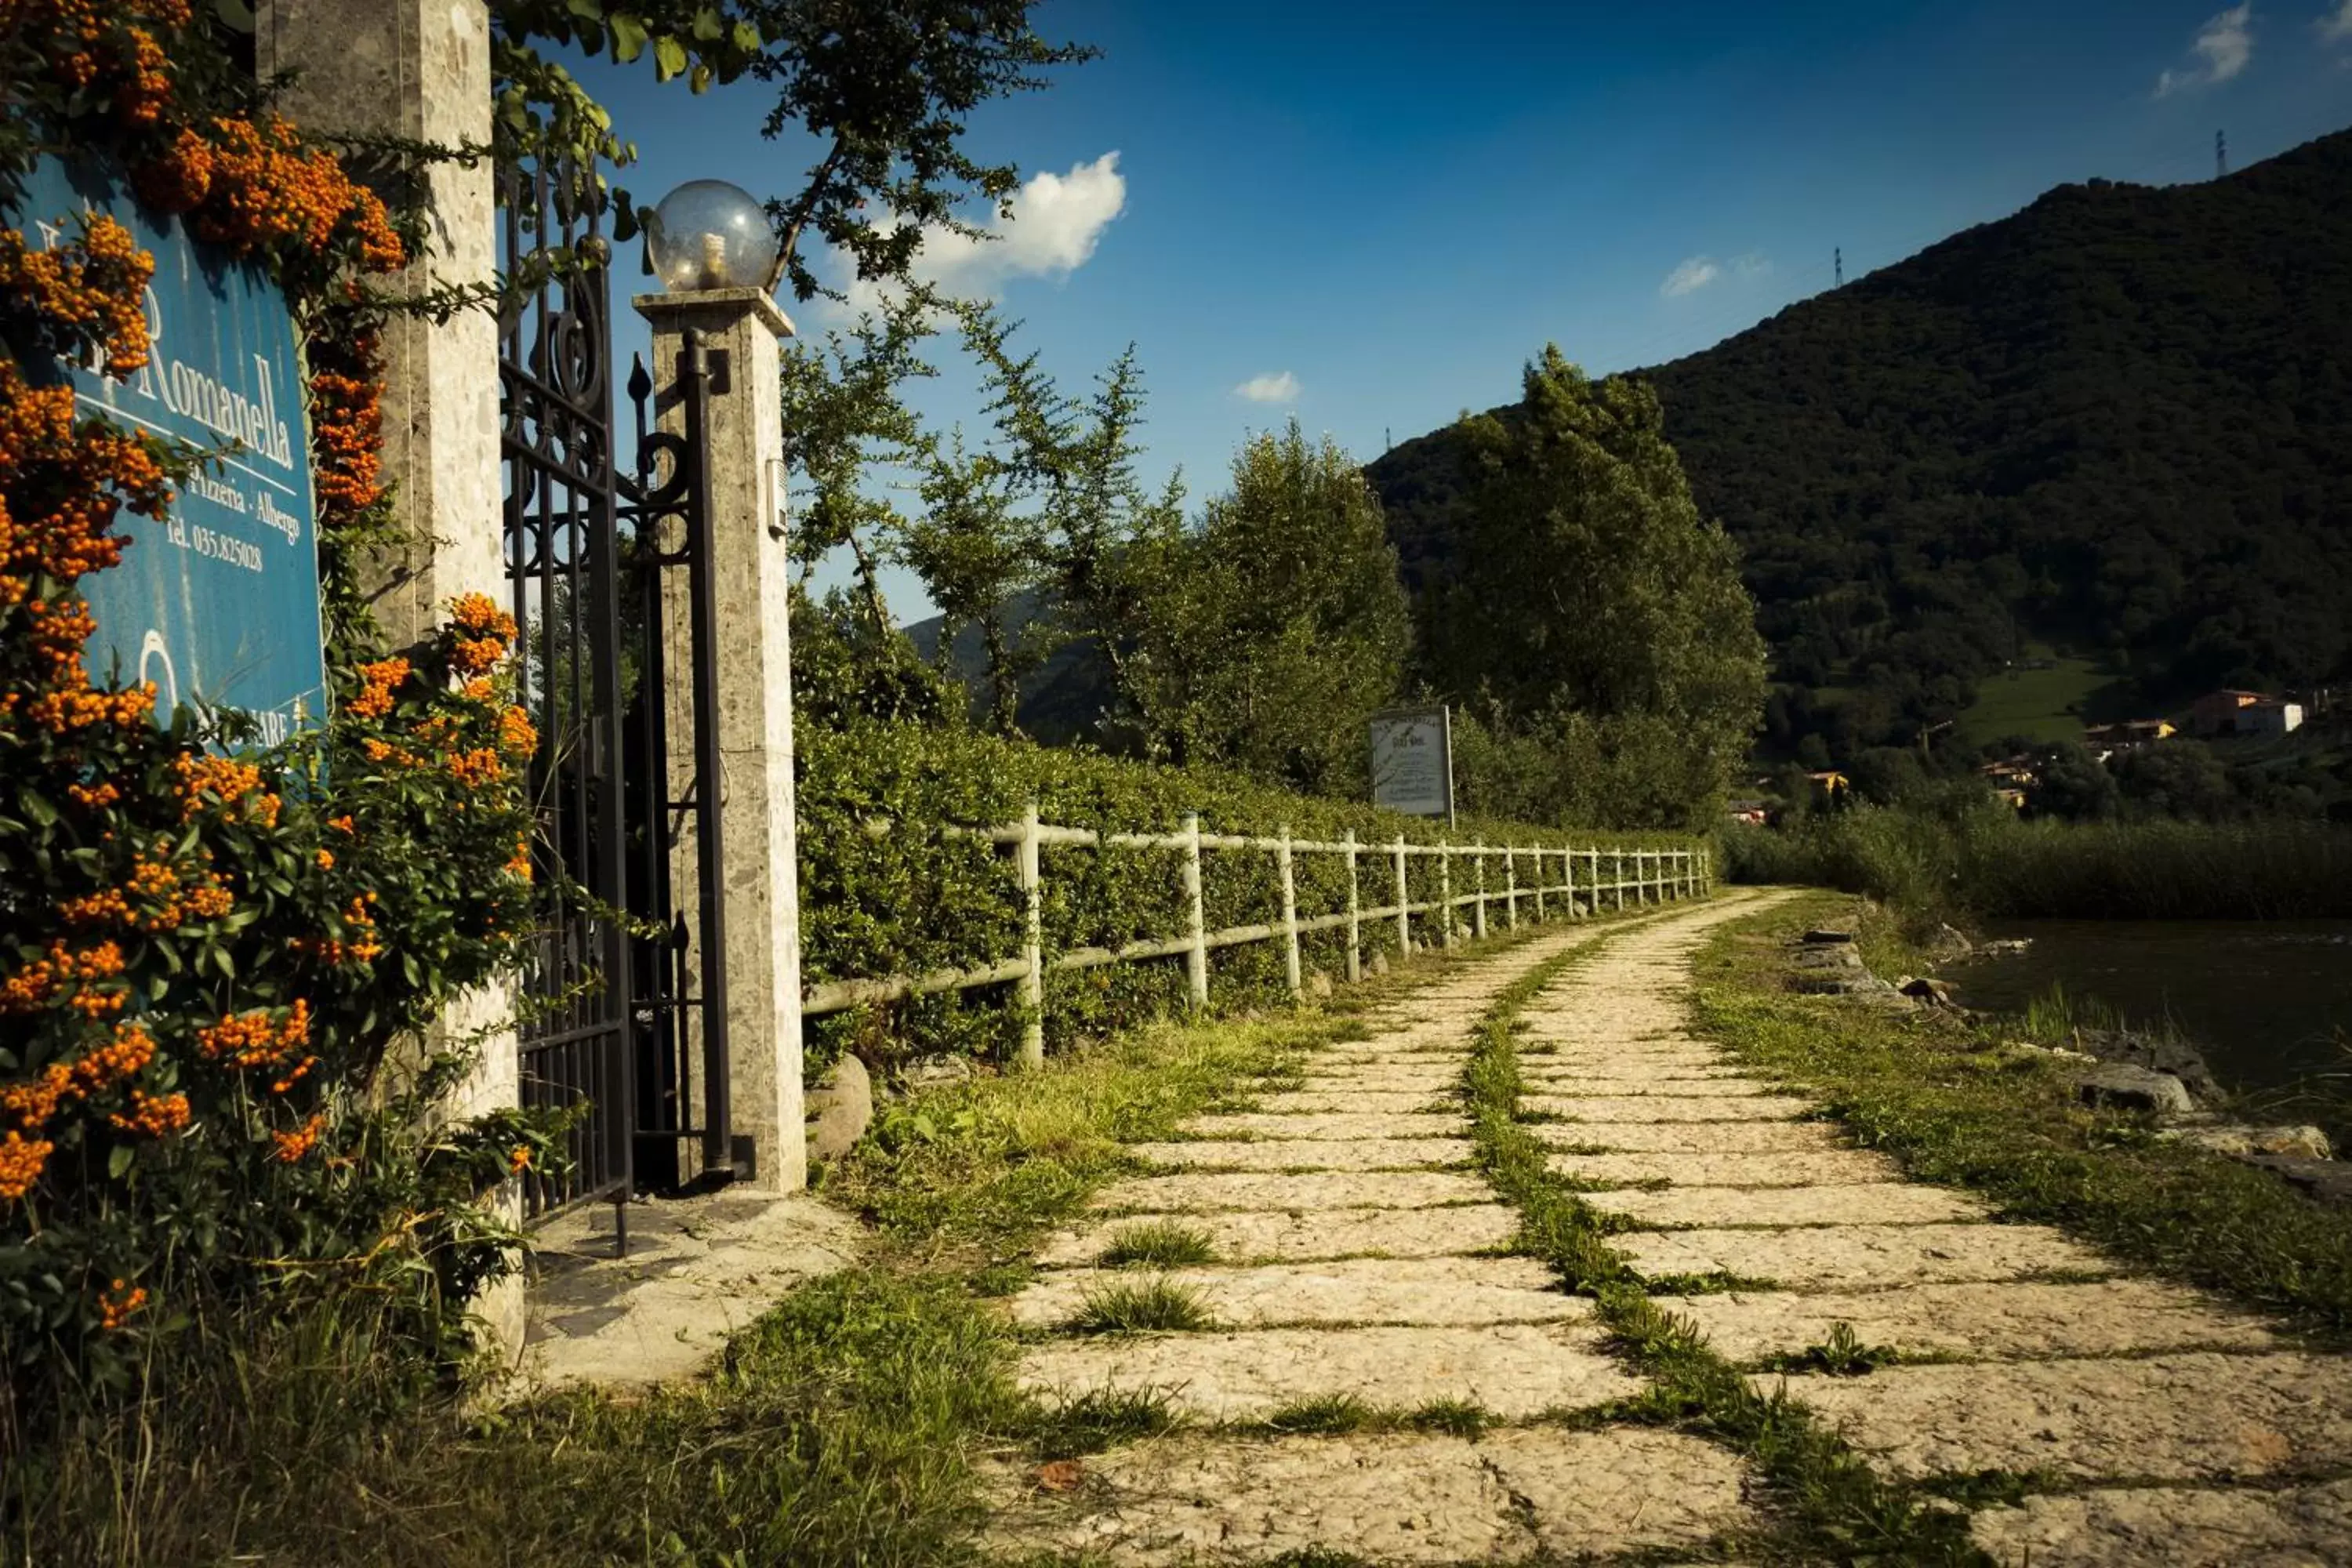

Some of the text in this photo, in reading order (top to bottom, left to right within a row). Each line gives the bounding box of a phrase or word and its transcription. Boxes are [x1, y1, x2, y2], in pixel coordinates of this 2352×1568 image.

[190, 462, 245, 514] Pizzeria
[256, 490, 300, 546] Albergo
[192, 524, 263, 573] 035.825028
